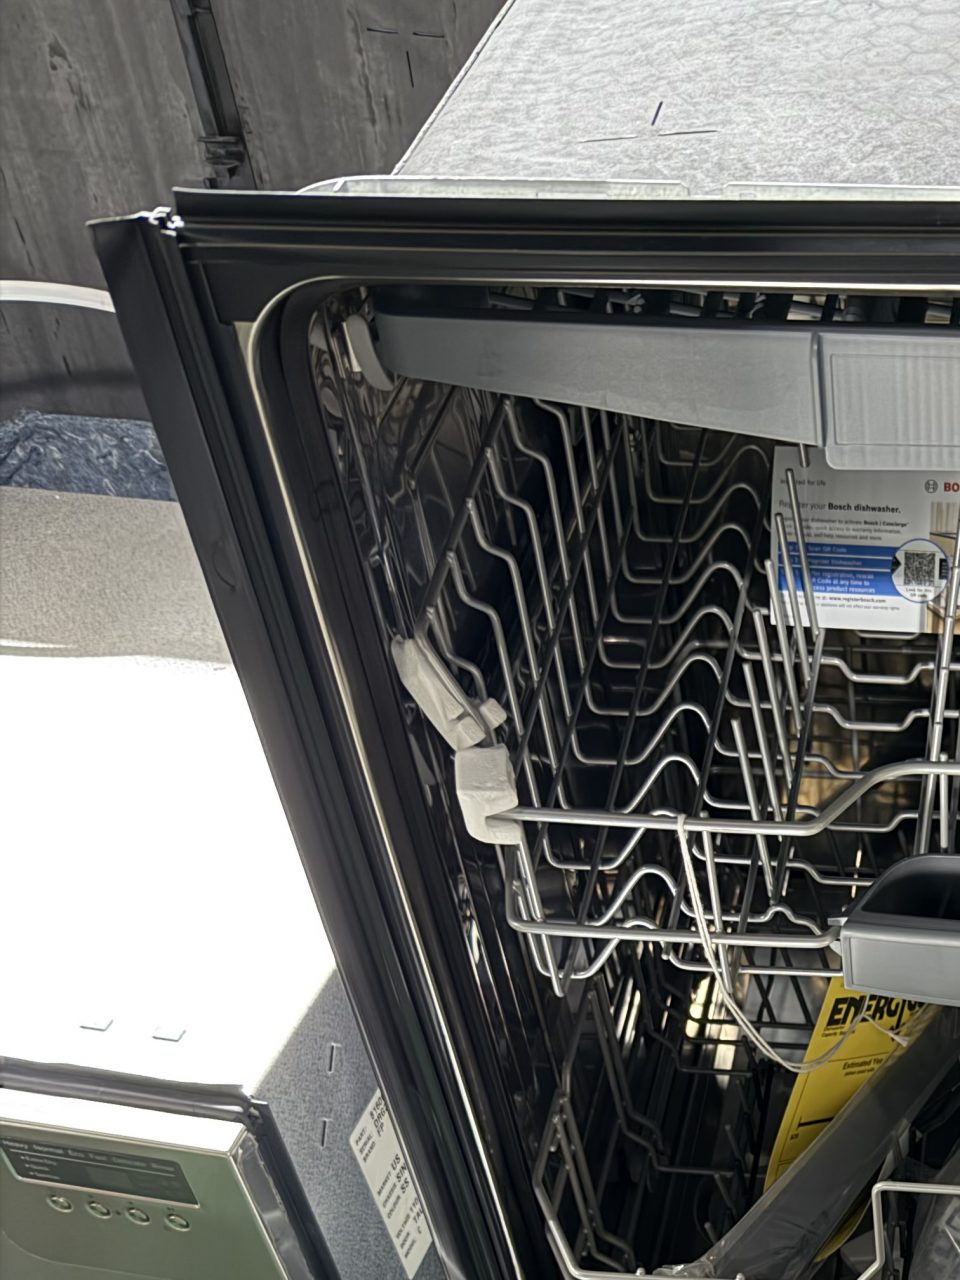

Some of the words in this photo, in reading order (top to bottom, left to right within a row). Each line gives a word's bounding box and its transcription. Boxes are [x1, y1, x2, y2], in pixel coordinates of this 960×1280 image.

[828, 502, 852, 511] Bosch
[854, 503, 901, 514] dishwasher.
[390, 1153, 401, 1171] US
[400, 1177, 410, 1194] SS
